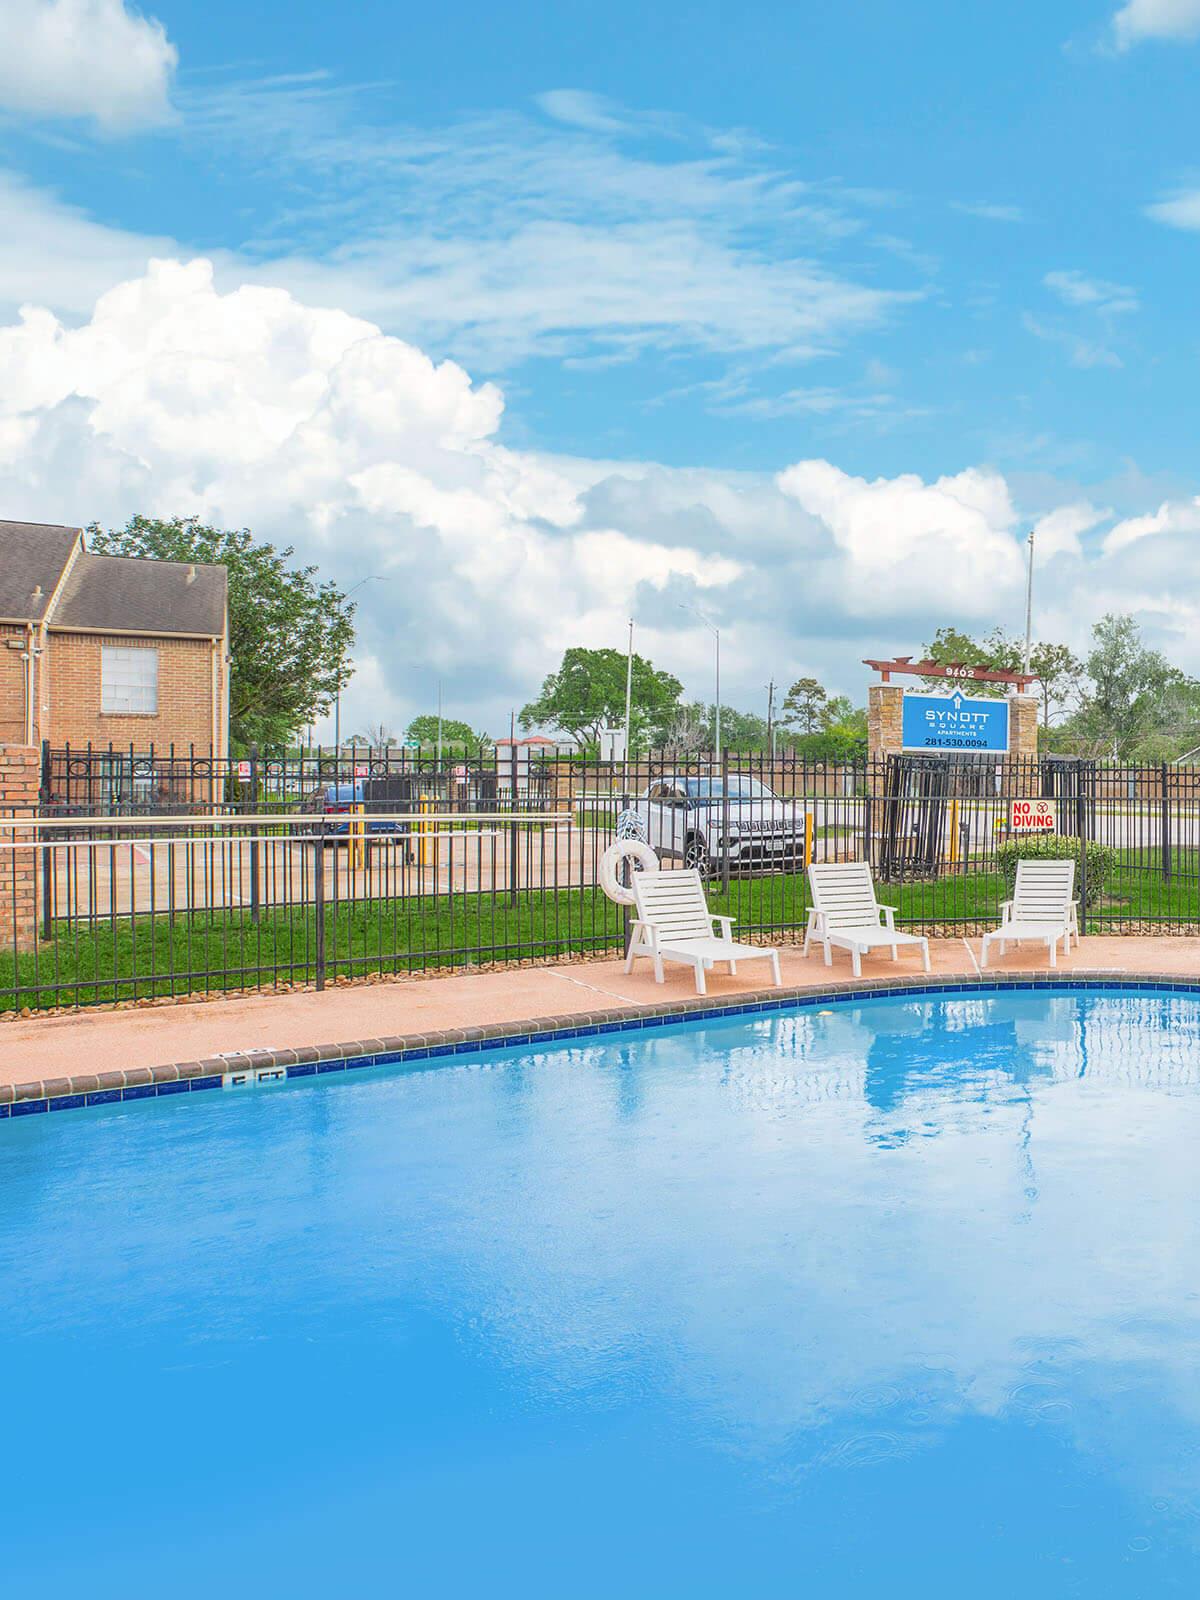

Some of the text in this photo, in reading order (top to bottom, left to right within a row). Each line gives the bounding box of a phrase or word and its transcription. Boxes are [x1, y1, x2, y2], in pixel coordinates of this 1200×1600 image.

[945, 667, 975, 678] 9402
[925, 710, 990, 723] SYNOTT
[928, 722, 985, 731] SQUARE
[937, 729, 978, 738] APARTMENTS
[925, 737, 988, 748] 281-530.0094
[1013, 802, 1031, 815] NO
[1013, 815, 1053, 827] DIVING
